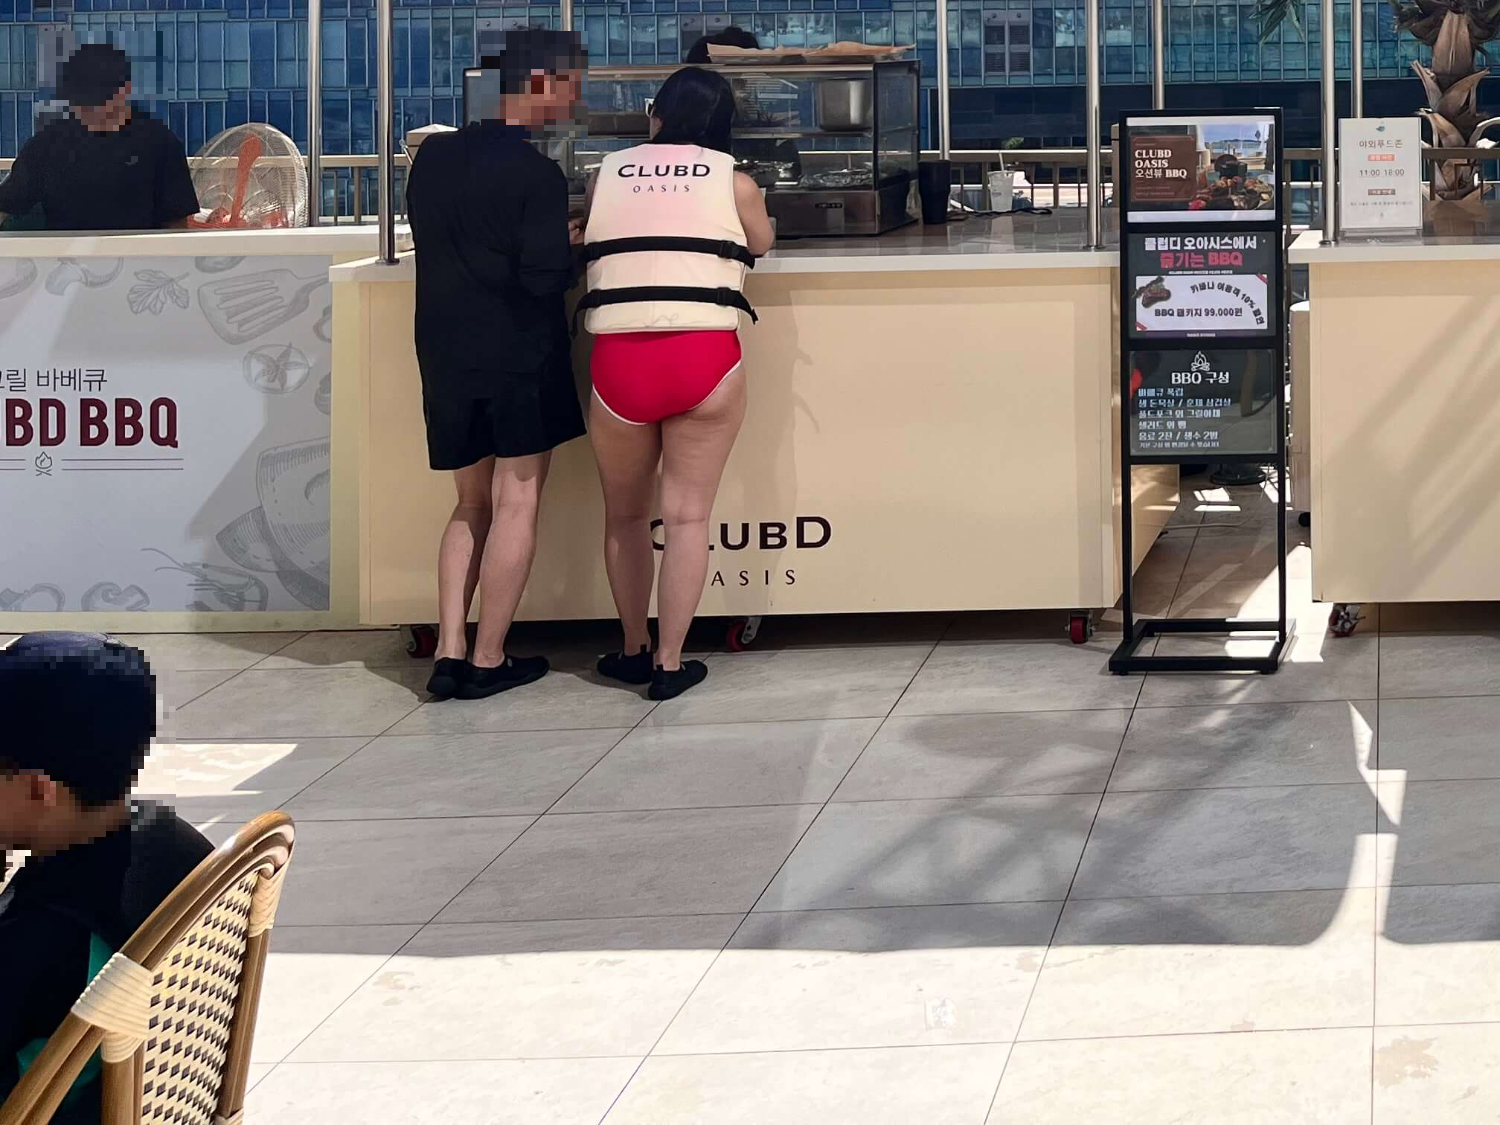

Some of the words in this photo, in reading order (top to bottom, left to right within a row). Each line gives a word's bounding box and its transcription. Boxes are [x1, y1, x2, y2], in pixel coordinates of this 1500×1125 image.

[1135, 150, 1172, 158] CLUBD
[618, 164, 710, 177] CLUBD
[1135, 160, 1169, 168] OASIS
[1165, 169, 1187, 179] BBQ
[633, 184, 690, 193] OASIS
[1145, 238, 1181, 250] 클럽디
[1184, 236, 1257, 250] 오아시스에서
[1160, 252, 1205, 268] 즐기는
[1208, 252, 1243, 266] BBQ
[37, 368, 108, 393] 바베큐
[1171, 372, 1202, 384] BBQ
[1205, 372, 1229, 384] 구성
[79, 396, 179, 449] BBQ
[711, 569, 796, 587] ASIS
